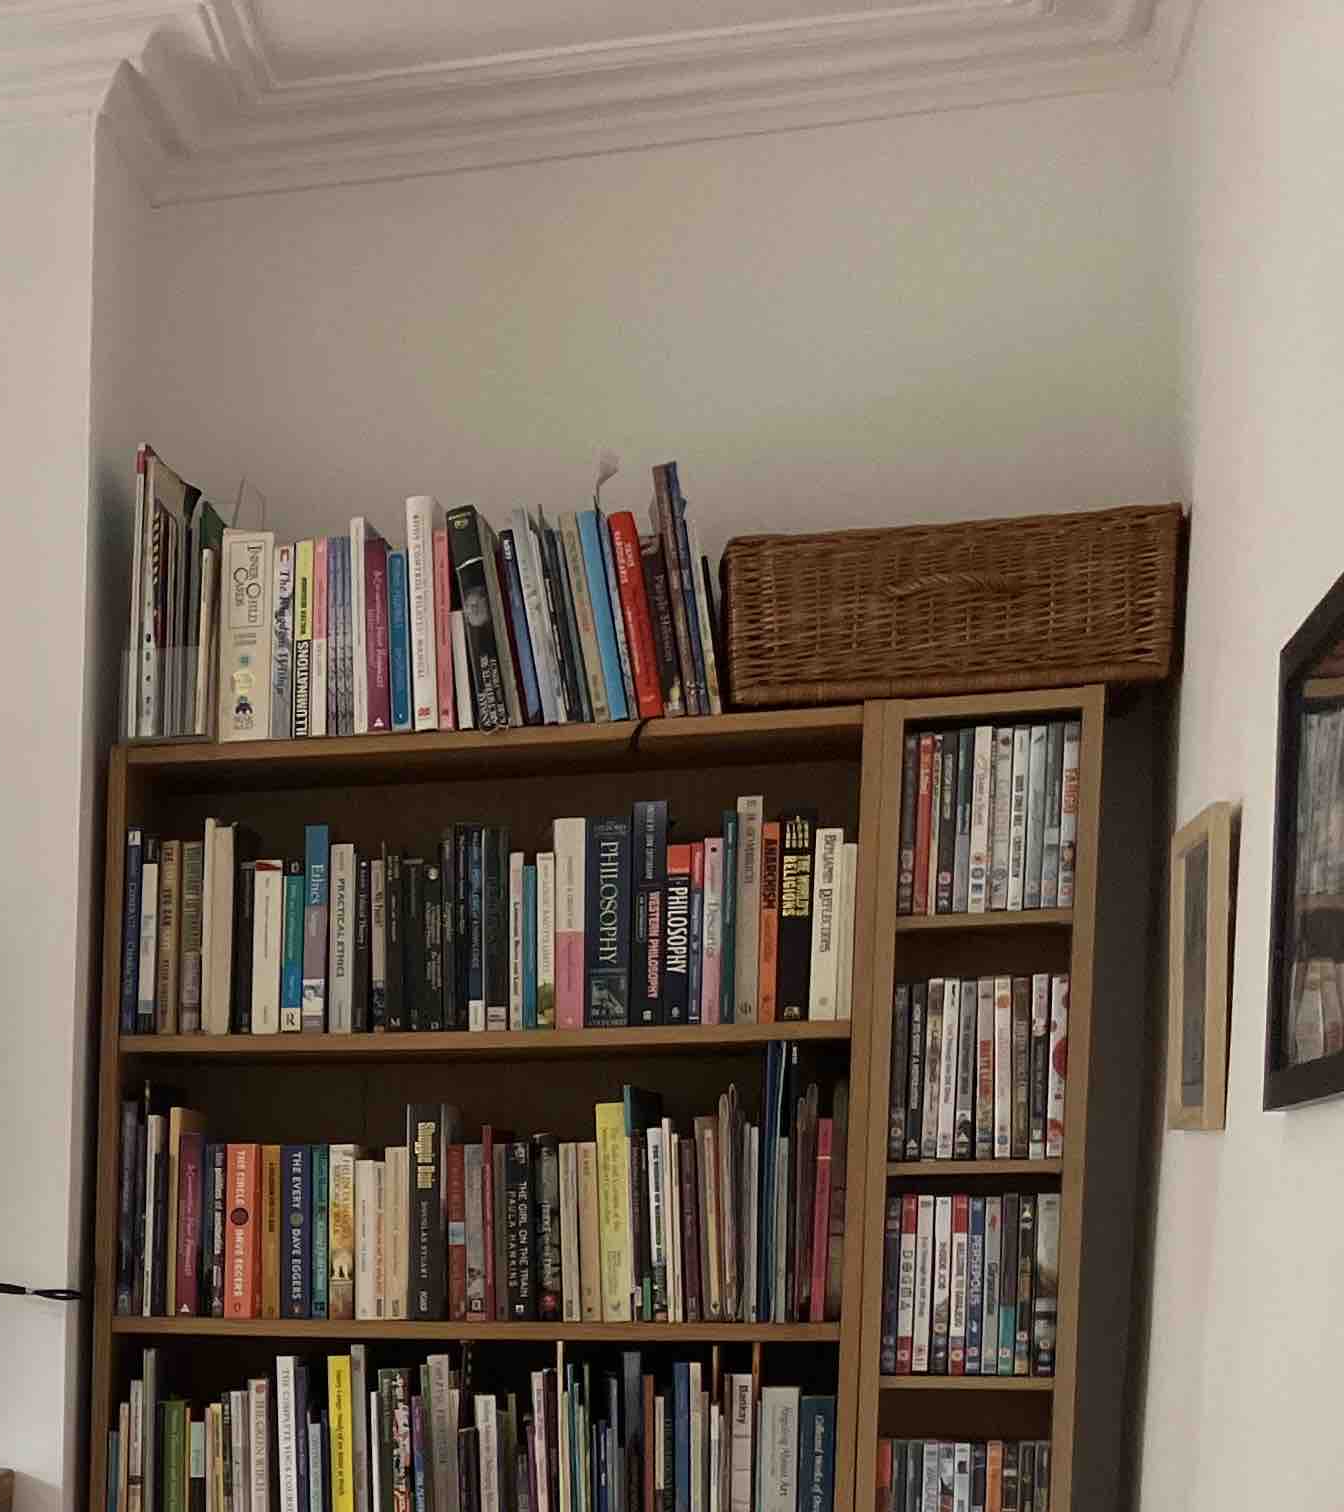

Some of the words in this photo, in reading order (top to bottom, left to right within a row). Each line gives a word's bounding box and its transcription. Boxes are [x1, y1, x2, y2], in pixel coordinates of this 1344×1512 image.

[279, 570, 291, 591] The
[413, 544, 423, 591] CONTROL
[416, 638, 425, 679] MANUAL
[295, 640, 310, 734] ILLUMINATIONS
[762, 838, 778, 910] ANARCHISM
[798, 855, 811, 872] THE
[311, 864, 325, 905] Ethics
[598, 840, 619, 964] PHILOSOPHY
[782, 855, 797, 917] RELIGIONS
[336, 878, 346, 938] PRACTICAL
[648, 890, 660, 938] WESTERN
[667, 886, 688, 974] PHILOSOPHY
[336, 940, 346, 977] ETHICS
[647, 939, 660, 998] PHILOSOPHY
[236, 1151, 246, 1169] THE
[292, 1151, 302, 1173] THE
[236, 1171, 246, 1205] CIRCLE
[291, 1175, 302, 1208] EVERY
[518, 1181, 528, 1200] THE
[508, 1191, 517, 1228] PAULA
[518, 1203, 528, 1226] GIRL
[291, 1228, 302, 1255] DAVE
[518, 1229, 528, 1245] ON
[519, 1247, 528, 1266] THE
[233, 1258, 244, 1296] EGGERS
[291, 1258, 302, 1299] EGGERS
[508, 1234, 517, 1287] HAWKINS
[970, 1234, 982, 1305] PERSEPOLIS
[519, 1267, 529, 1297] TRAIN
[736, 1384, 750, 1425] Banksy
[813, 1413, 825, 1454] Collected
[779, 1481, 791, 1497] Art
